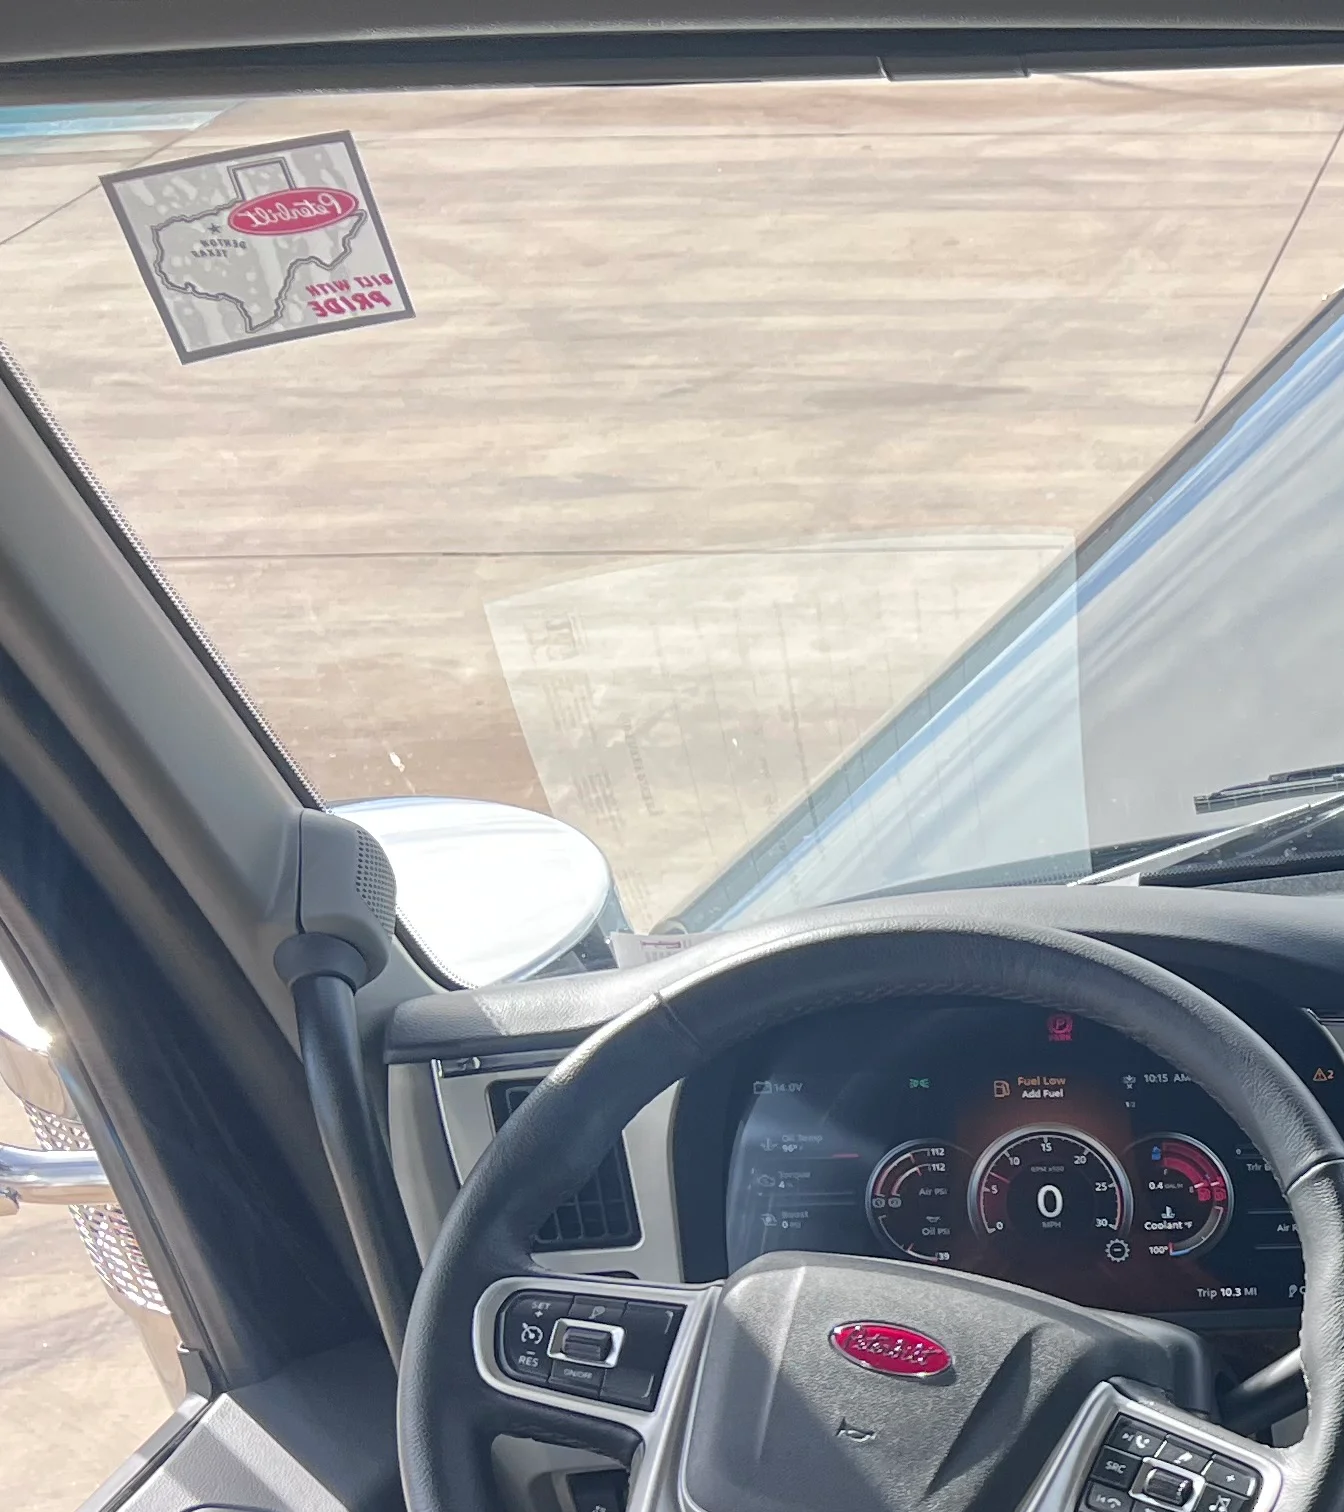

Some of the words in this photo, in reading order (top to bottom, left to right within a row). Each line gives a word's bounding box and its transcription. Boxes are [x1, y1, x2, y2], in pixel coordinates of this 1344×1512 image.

[1327, 1071, 1335, 1080] 2
[1018, 1076, 1040, 1086] Fuel
[1043, 1077, 1067, 1086] Low
[1022, 1089, 1041, 1099] Add
[1043, 1089, 1064, 1098] Fuel
[1041, 1143, 1052, 1152] 15
[1010, 1157, 1020, 1166] 10
[1074, 1155, 1087, 1165] 20
[1095, 1182, 1107, 1191] 25
[1149, 1181, 1164, 1190] 0.4
[1037, 1184, 1063, 1218] 0
[1095, 1218, 1108, 1227] 30
[1144, 1221, 1182, 1230] Coolant
[1197, 1288, 1217, 1299] Trip
[1220, 1287, 1242, 1297] 10.3
[531, 1302, 552, 1311] SET
[518, 1355, 539, 1369] RES
[1105, 1460, 1127, 1475] SRC
